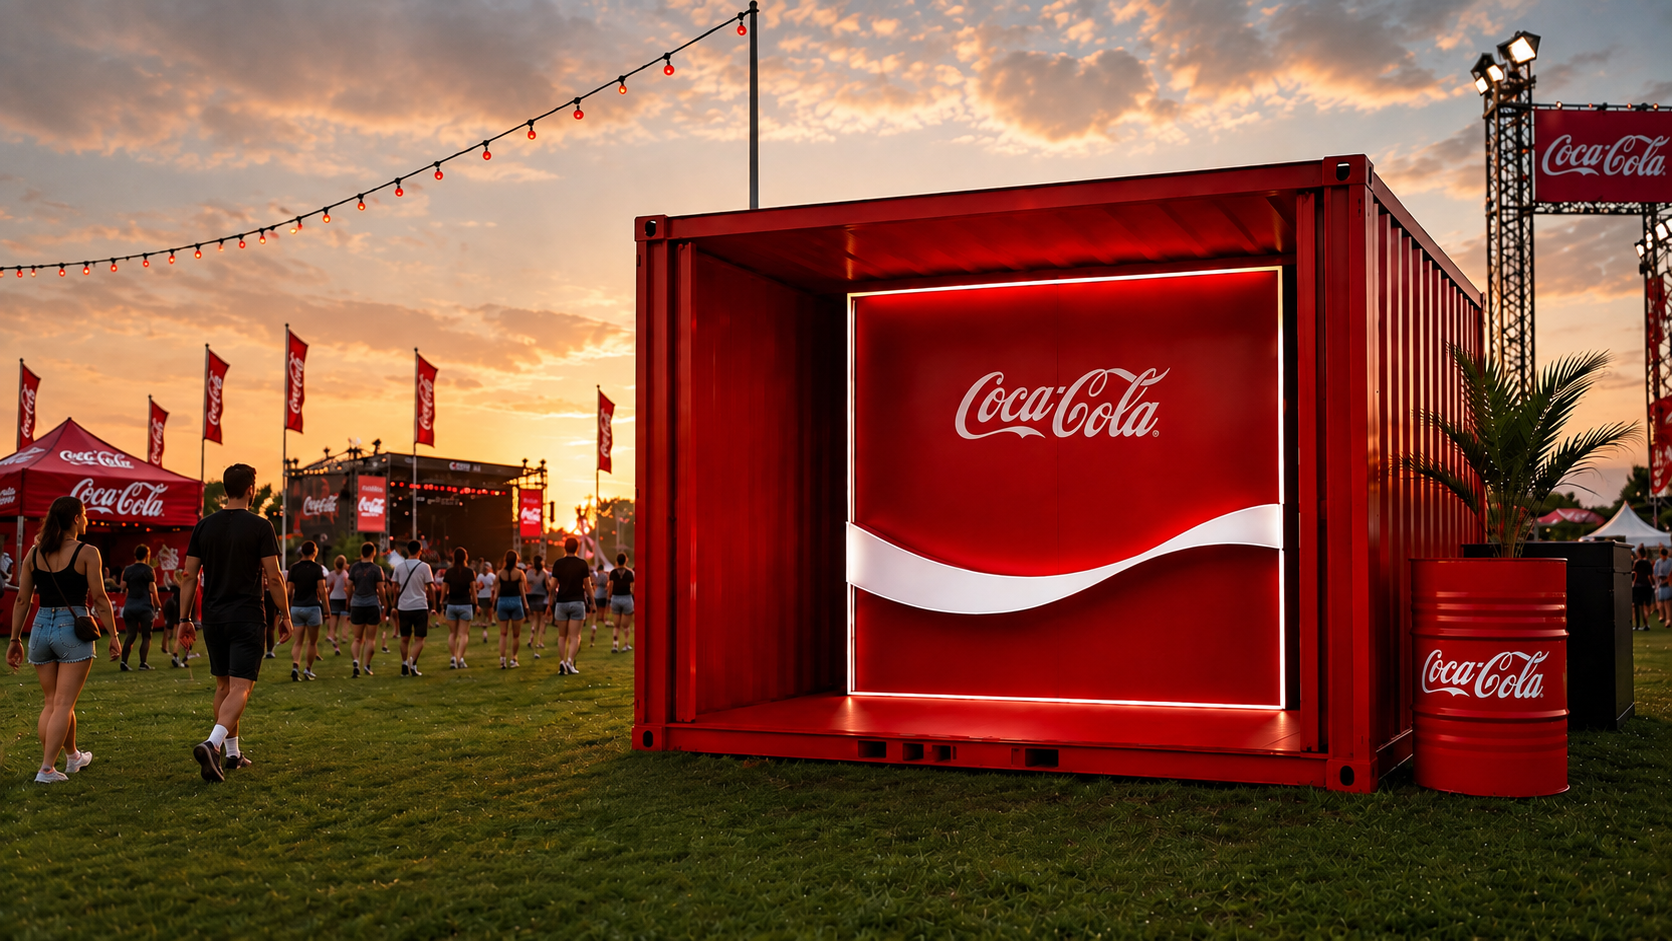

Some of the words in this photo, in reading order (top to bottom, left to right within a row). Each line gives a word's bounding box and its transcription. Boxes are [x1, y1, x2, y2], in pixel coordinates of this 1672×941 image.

[1541, 134, 1671, 177] Coca-Cola
[955, 367, 1171, 440] Coca-Cola
[69, 478, 169, 517] Coca-Cola
[1422, 649, 1550, 699] Coca-Cola
